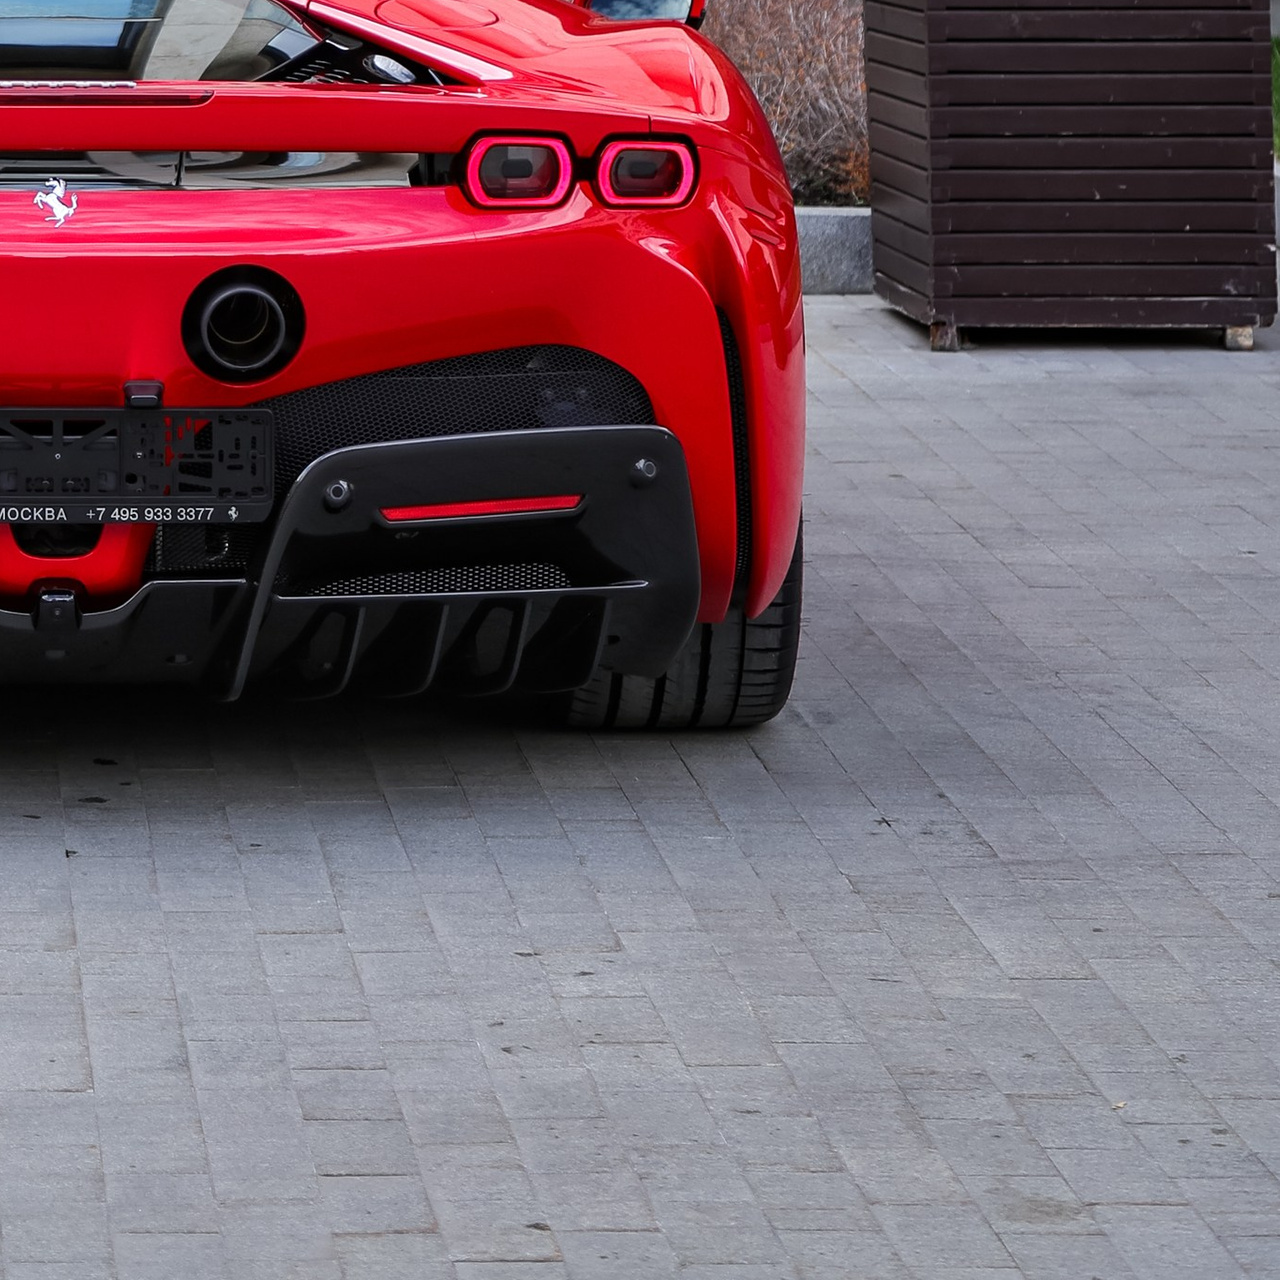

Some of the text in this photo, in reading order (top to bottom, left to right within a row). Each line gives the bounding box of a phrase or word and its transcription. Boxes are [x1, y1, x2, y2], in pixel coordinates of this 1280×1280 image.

[85, 507, 106, 521] +7
[110, 507, 139, 521] 495
[144, 507, 173, 521] 933
[176, 507, 215, 521] 3377
